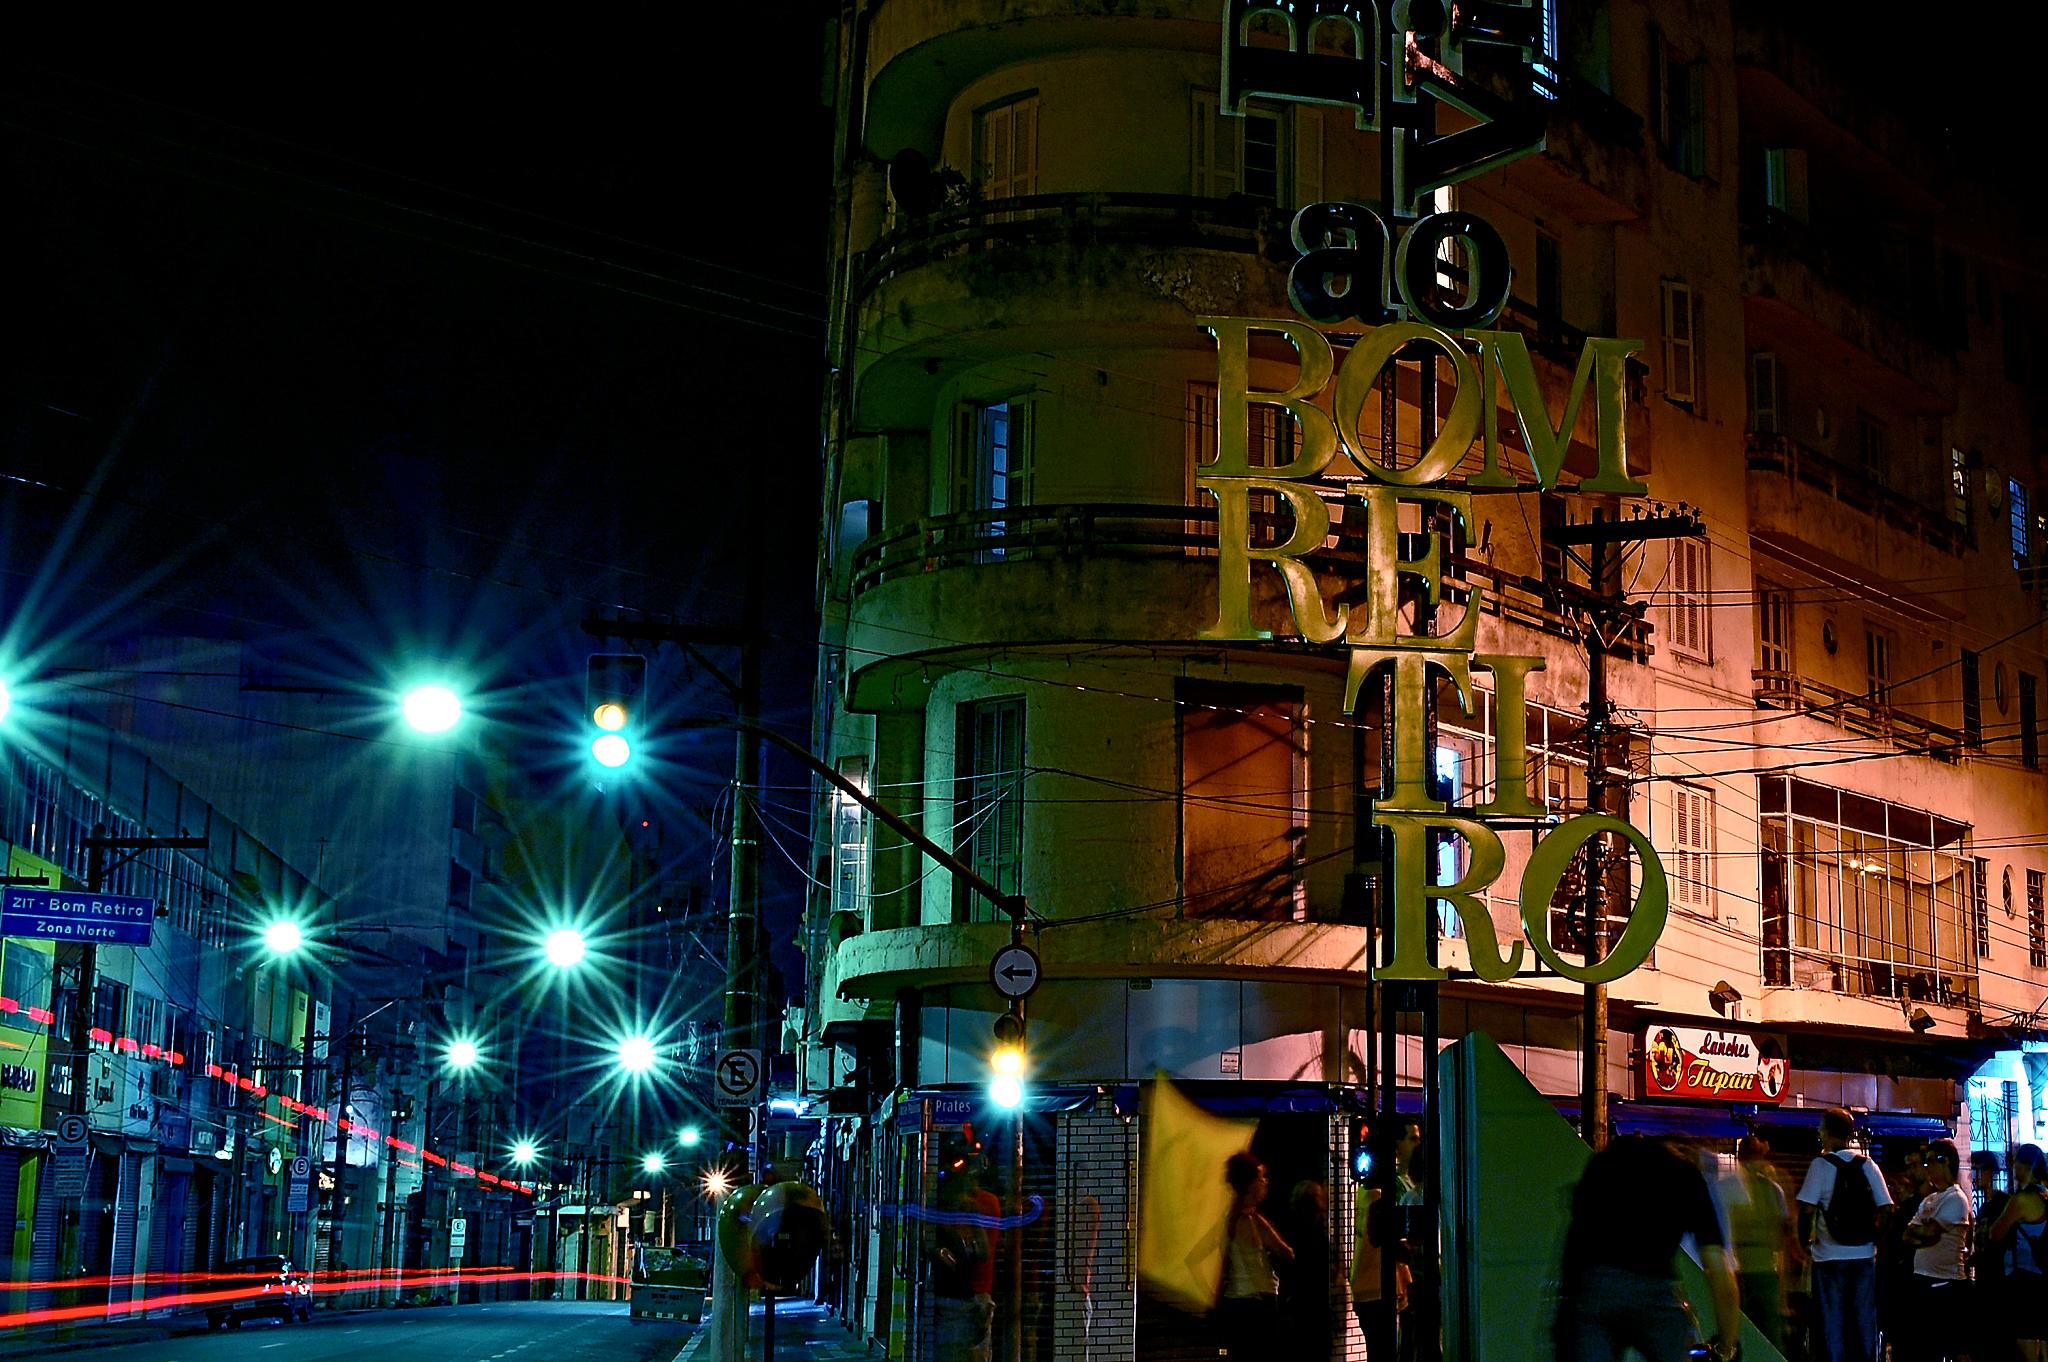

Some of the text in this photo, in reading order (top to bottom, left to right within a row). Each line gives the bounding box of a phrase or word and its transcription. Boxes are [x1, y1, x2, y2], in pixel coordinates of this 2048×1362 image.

[1196, 315, 1648, 494] BOM
[12, 897, 35, 909] ZIT
[48, 898, 86, 913] Bom
[91, 901, 144, 917] Retiro
[36, 921, 116, 937] Zona Norte
[1699, 1032, 1750, 1058] Lanches
[935, 1099, 971, 1113] Prates
